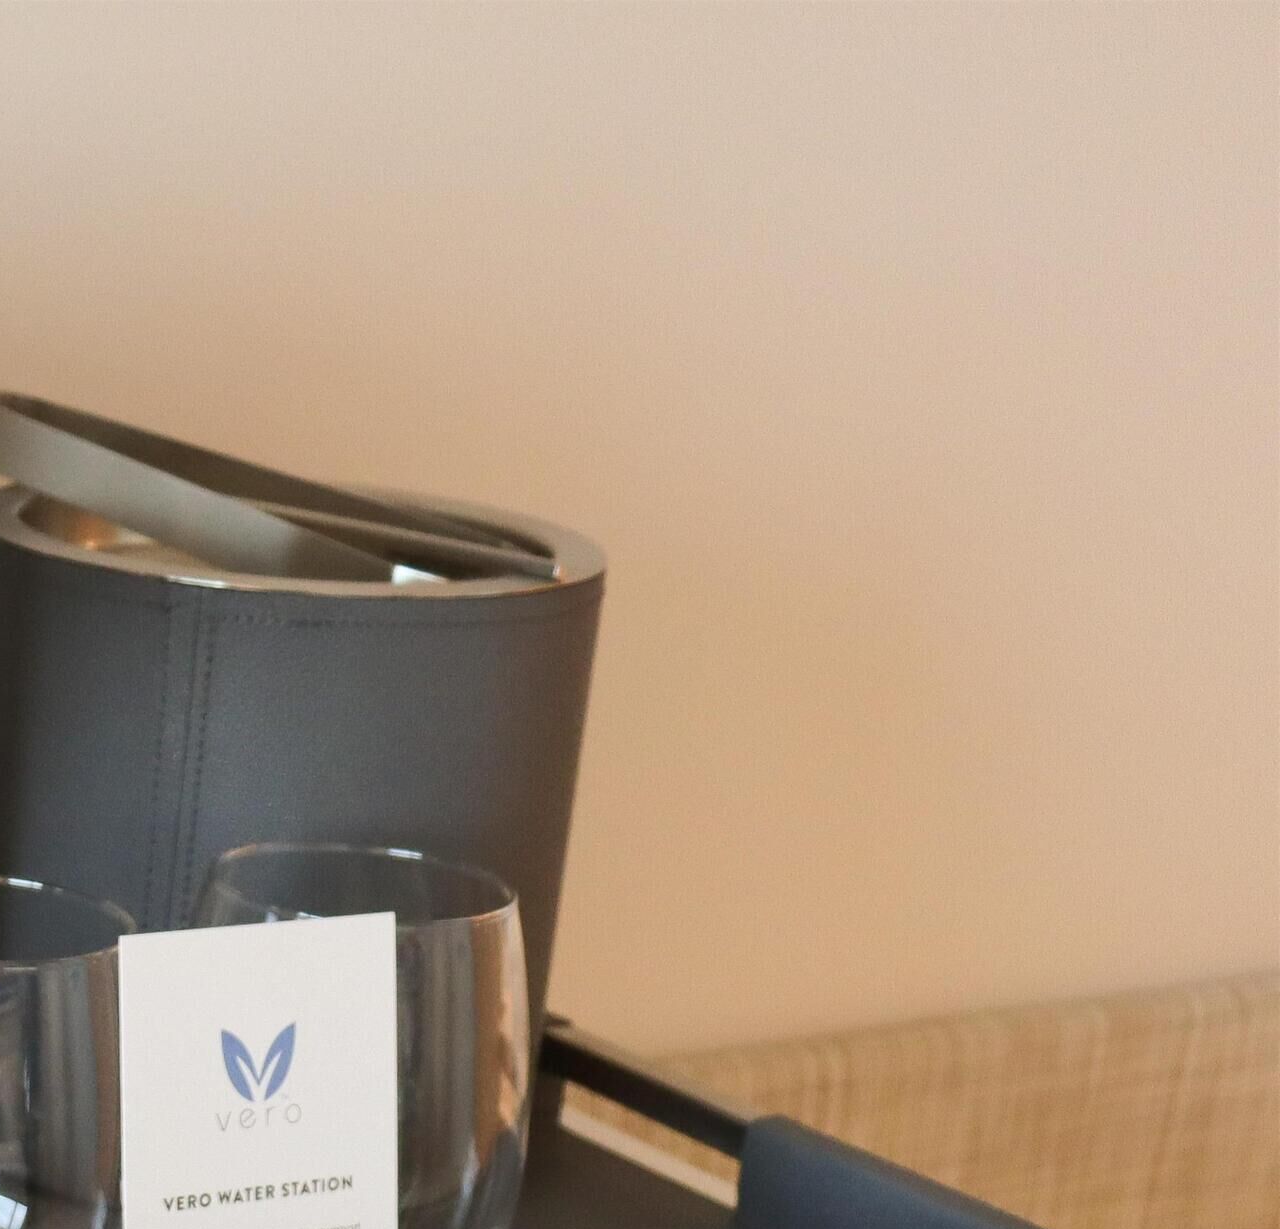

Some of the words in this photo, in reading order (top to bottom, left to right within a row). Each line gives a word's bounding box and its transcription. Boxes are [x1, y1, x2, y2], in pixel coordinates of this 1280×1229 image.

[216, 1103, 302, 1132] vero
[162, 1193, 212, 1212] VERO
[218, 1184, 275, 1205] WATER
[282, 1176, 354, 1198] STATION
